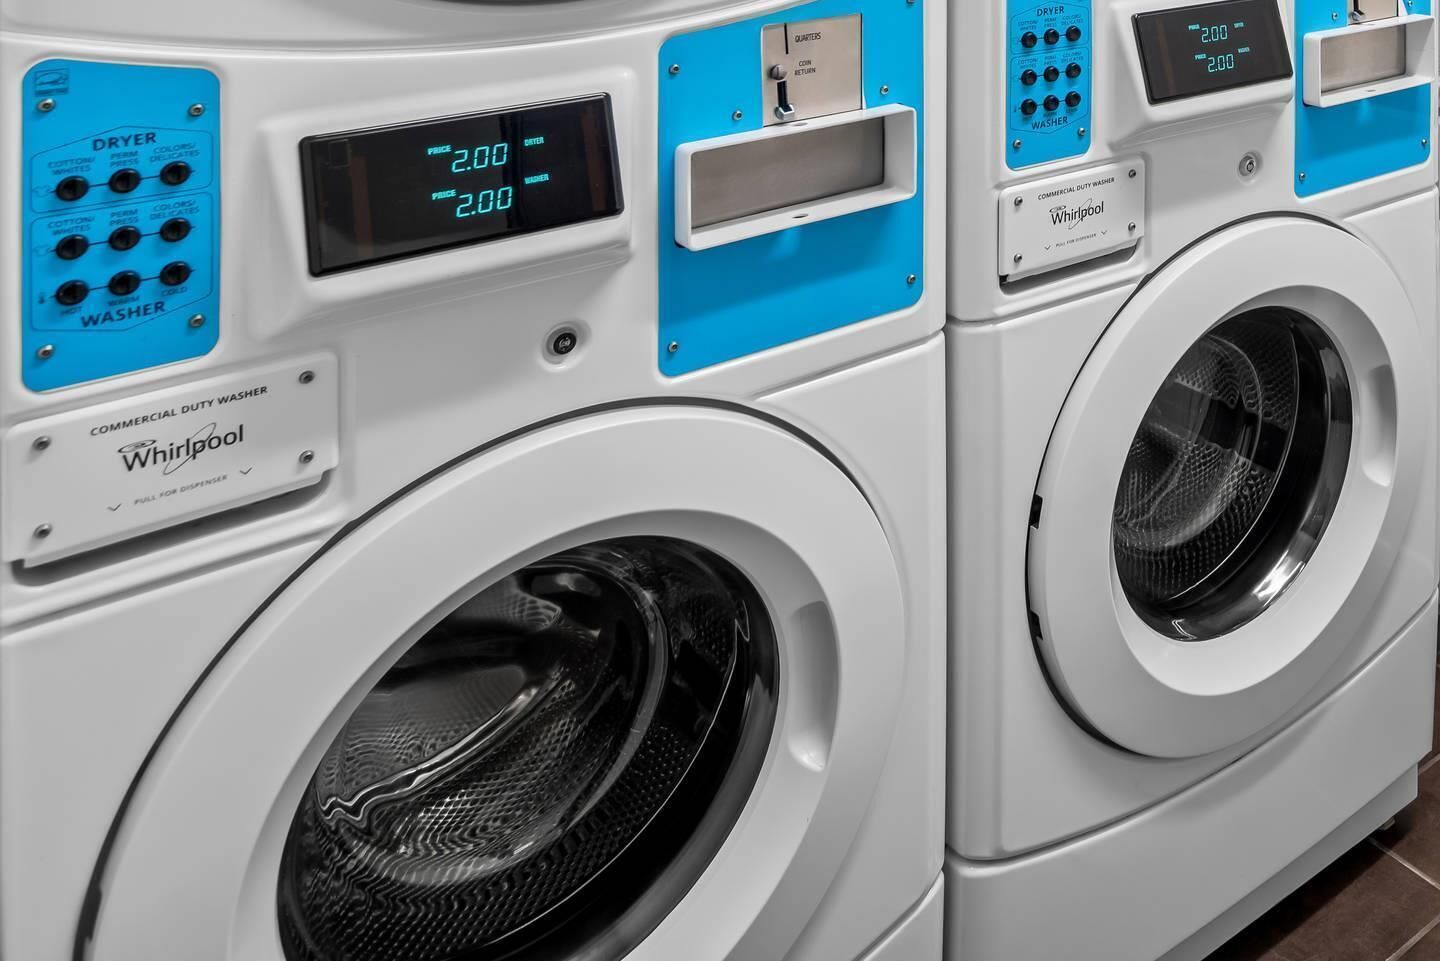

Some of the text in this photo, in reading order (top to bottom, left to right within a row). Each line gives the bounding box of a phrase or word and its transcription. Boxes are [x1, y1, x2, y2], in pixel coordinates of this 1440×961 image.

[1036, 6, 1064, 16] DRYER
[795, 32, 822, 43] QUARTERS
[1201, 24, 1228, 43] 2.00
[794, 67, 816, 76] RETURN
[1208, 53, 1234, 73] 2.00
[1032, 116, 1068, 130] WASHER
[92, 132, 156, 152] DRYER
[110, 151, 138, 160] PERM
[110, 158, 138, 168] PRESS
[150, 150, 200, 162] DELICATES
[428, 145, 451, 155] PRICE
[452, 143, 508, 173] 2.00
[1037, 177, 1115, 200] COMMERCIAL DUTY WASHER
[432, 189, 456, 200] PRICE
[456, 186, 512, 218] 2.00
[110, 209, 138, 218] PERM
[110, 217, 138, 226] PRESS
[1051, 200, 1104, 225] Whirlpool
[81, 301, 166, 328] WASHER
[90, 386, 268, 436] COMMERCIAL DUTY WASHER
[122, 424, 244, 472] Whirlpool
[134, 475, 228, 505] PULL FOR DISPENSER
